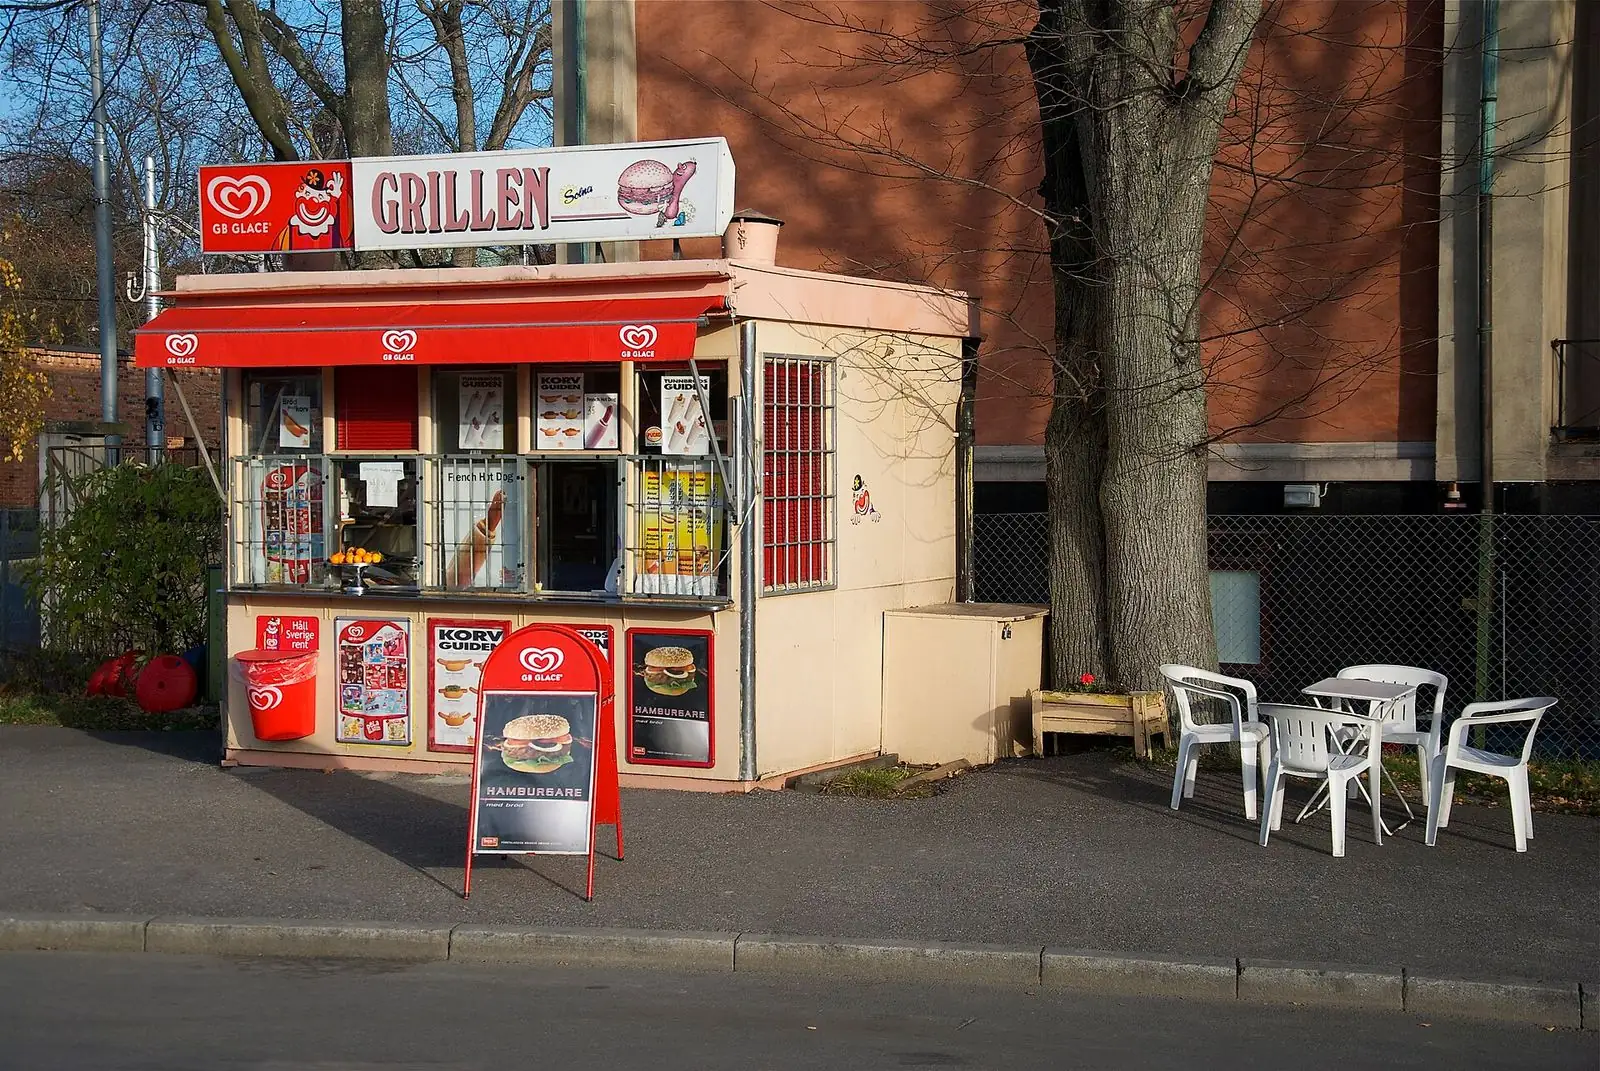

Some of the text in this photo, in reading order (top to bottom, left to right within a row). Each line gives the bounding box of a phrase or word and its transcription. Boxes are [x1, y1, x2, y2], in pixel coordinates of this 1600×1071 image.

[563, 185, 593, 204] Solna
[372, 167, 550, 234] GRILLEN
[212, 222, 269, 234] GB GLACE
[383, 353, 415, 361] GB GLACE
[621, 350, 655, 358] GB GLACE
[541, 376, 581, 384] KORV
[496, 472, 514, 483] Dog
[292, 620, 308, 631] Håll
[285, 629, 315, 641] Sverige
[439, 629, 504, 642] KORV
[291, 641, 309, 649] rent
[521, 673, 561, 682] GB GLACE
